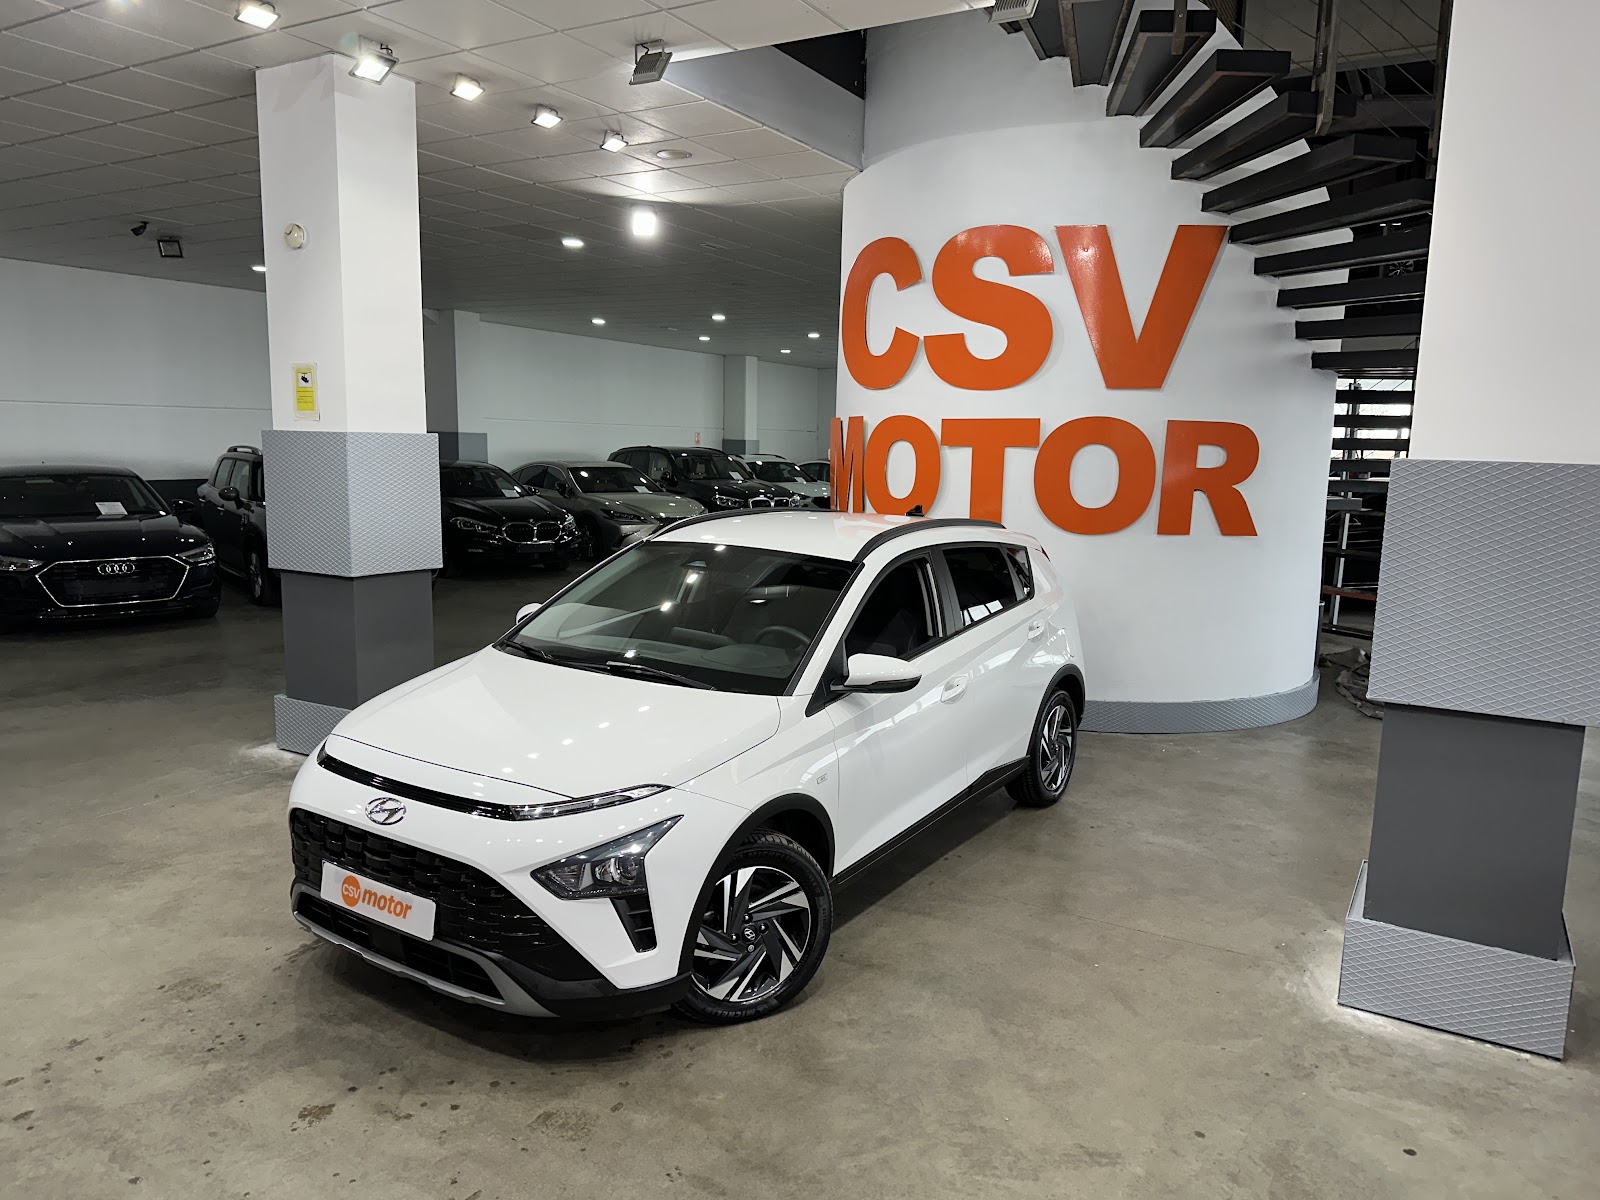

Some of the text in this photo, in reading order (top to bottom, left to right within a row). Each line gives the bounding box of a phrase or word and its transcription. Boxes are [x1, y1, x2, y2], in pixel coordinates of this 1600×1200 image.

[842, 225, 1230, 391] CSV
[830, 415, 1260, 537] MOTOR
[363, 889, 413, 919] motor
